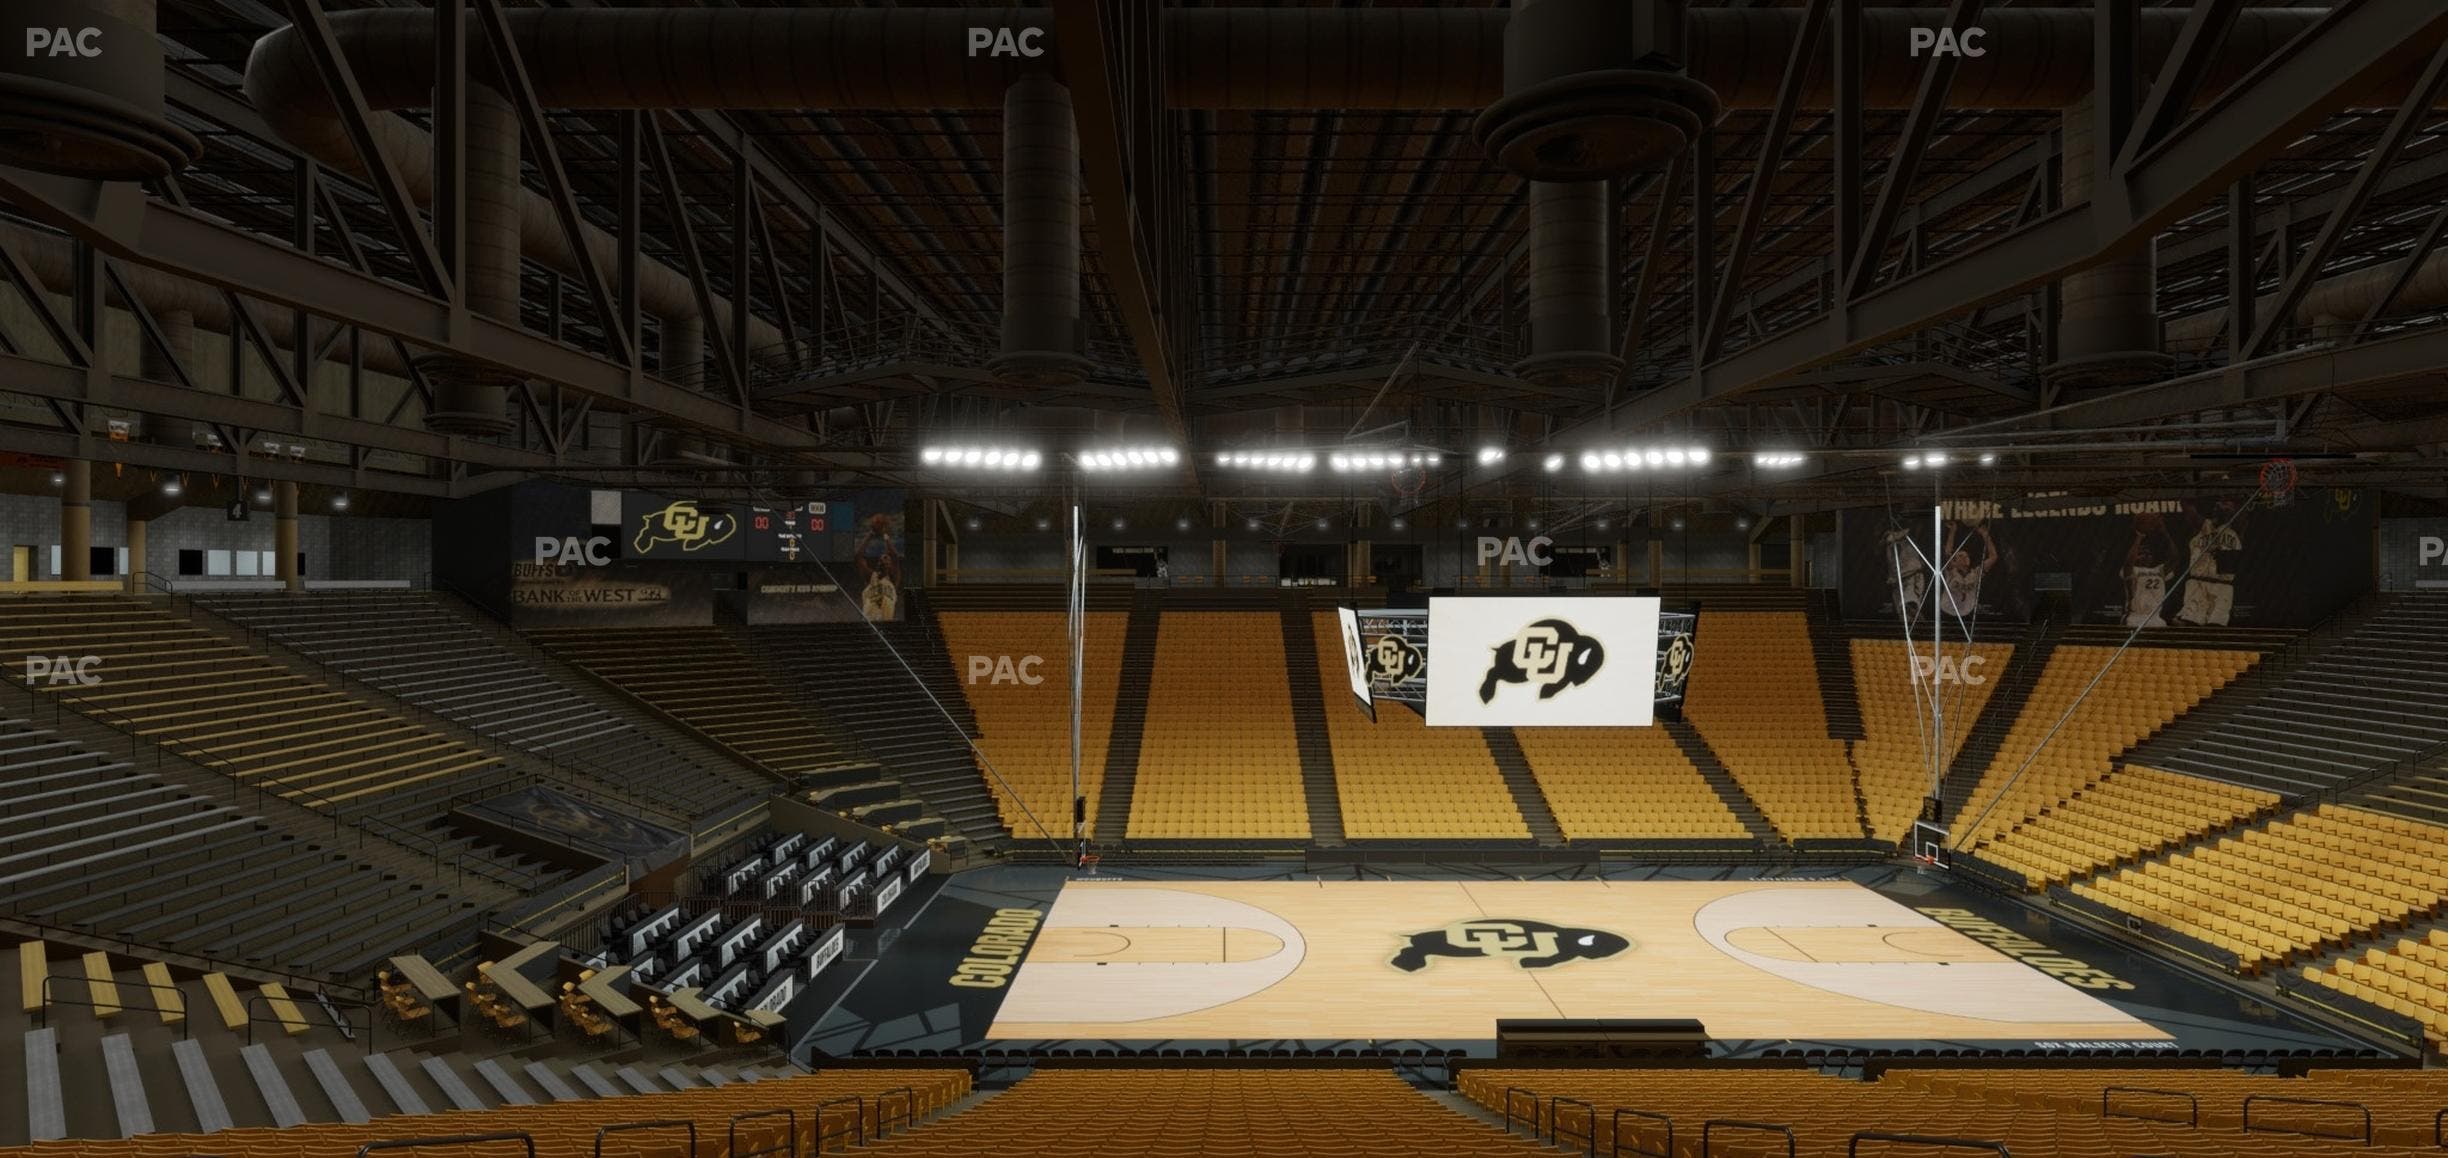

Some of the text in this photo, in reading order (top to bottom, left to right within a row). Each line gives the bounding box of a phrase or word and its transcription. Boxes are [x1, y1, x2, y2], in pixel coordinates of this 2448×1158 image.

[232, 503, 242, 518] 4
[513, 589, 565, 604] BANK
[584, 588, 635, 602] WEST
[2145, 578, 2160, 589] 22
[1512, 626, 1574, 684] CU
[948, 908, 1043, 989] COLORADO
[1914, 906, 2137, 990] BUFFALOES
